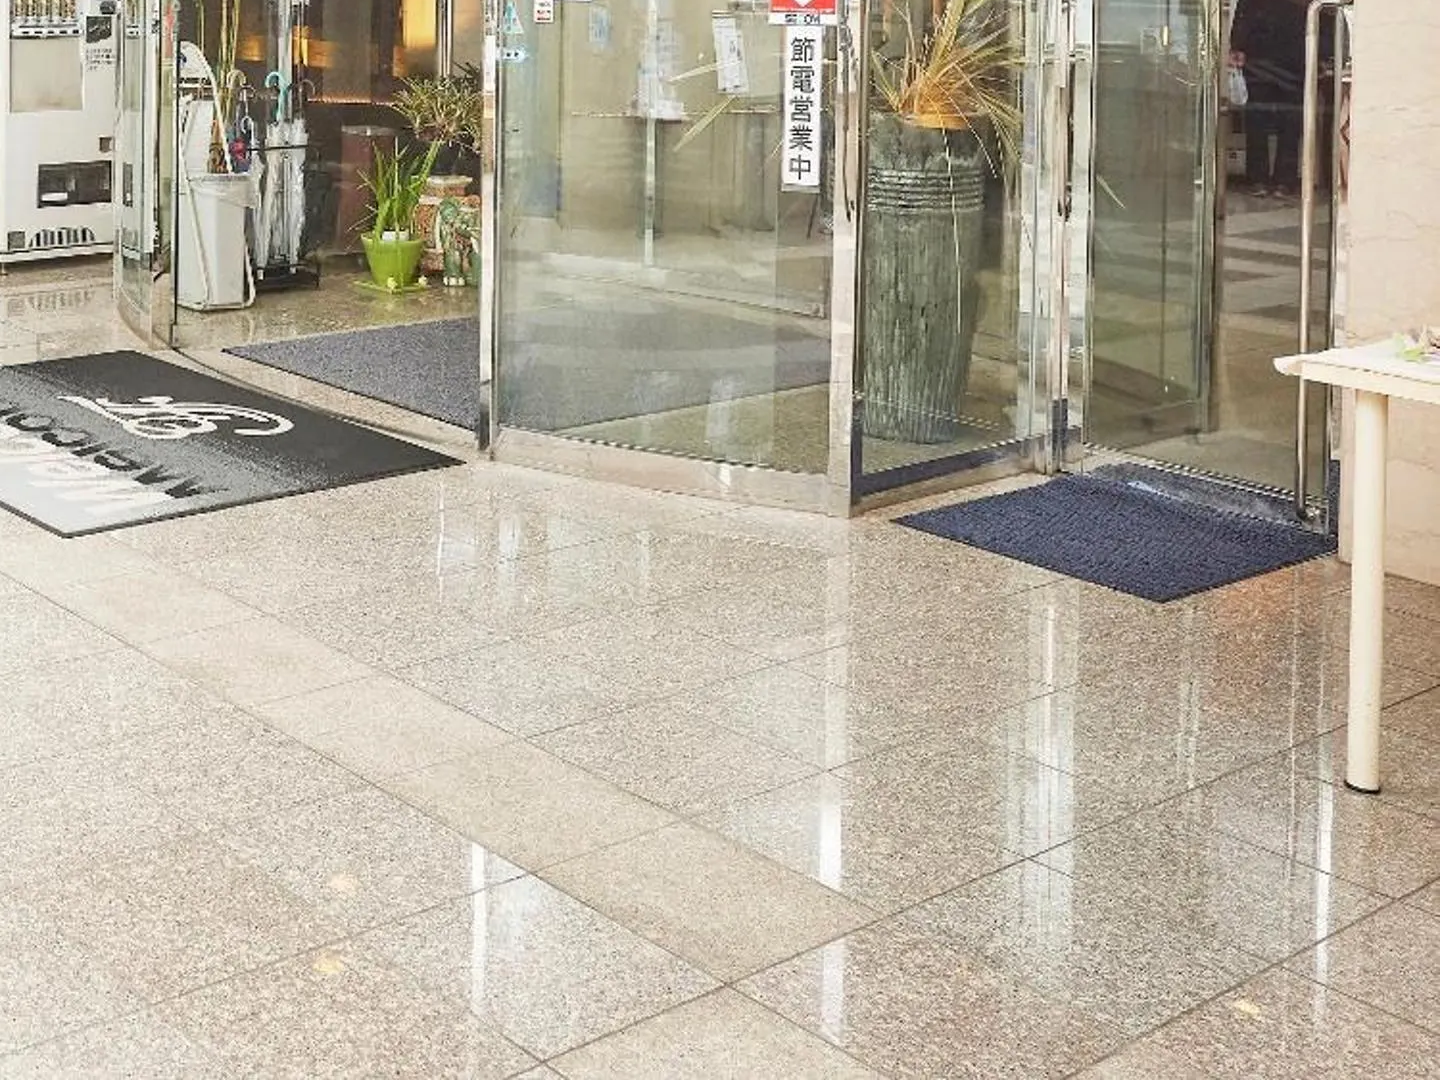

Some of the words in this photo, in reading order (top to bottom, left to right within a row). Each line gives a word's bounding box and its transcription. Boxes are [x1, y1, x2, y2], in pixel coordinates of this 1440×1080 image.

[788, 36, 816, 181] 節電営業中
